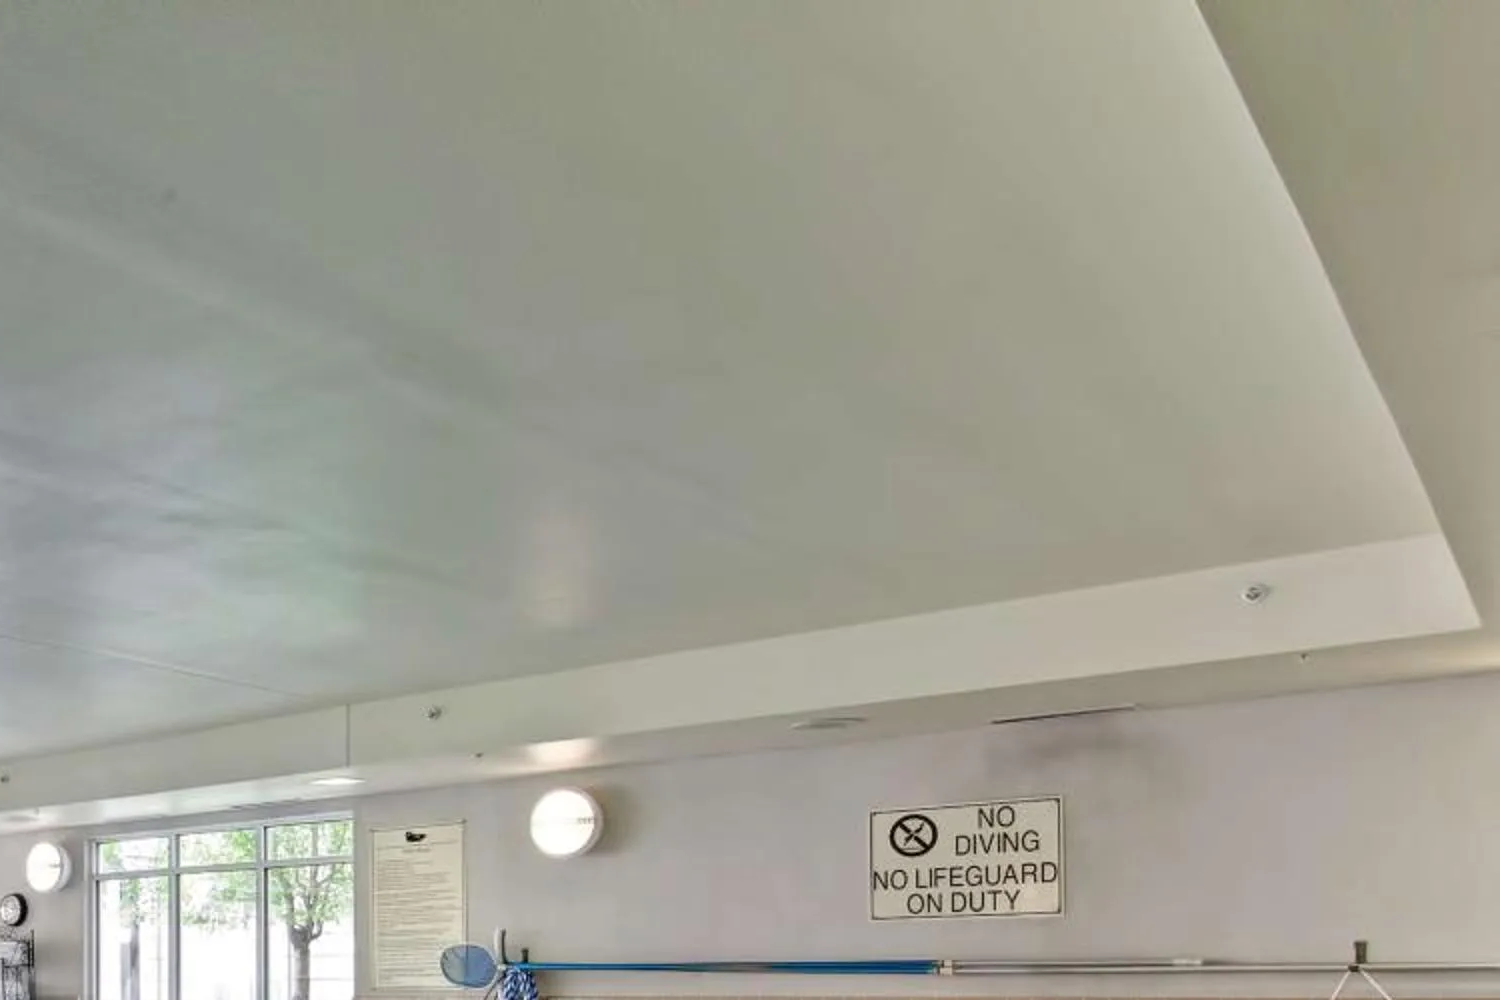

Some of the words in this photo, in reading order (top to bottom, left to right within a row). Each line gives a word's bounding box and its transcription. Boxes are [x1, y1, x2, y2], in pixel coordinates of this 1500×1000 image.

[977, 805, 1015, 829] NO
[955, 830, 1041, 857] DIVING
[873, 868, 908, 891] NO
[915, 862, 1058, 889] LIFEGUARD
[907, 892, 943, 914] ON
[951, 889, 1021, 913] DUTY
